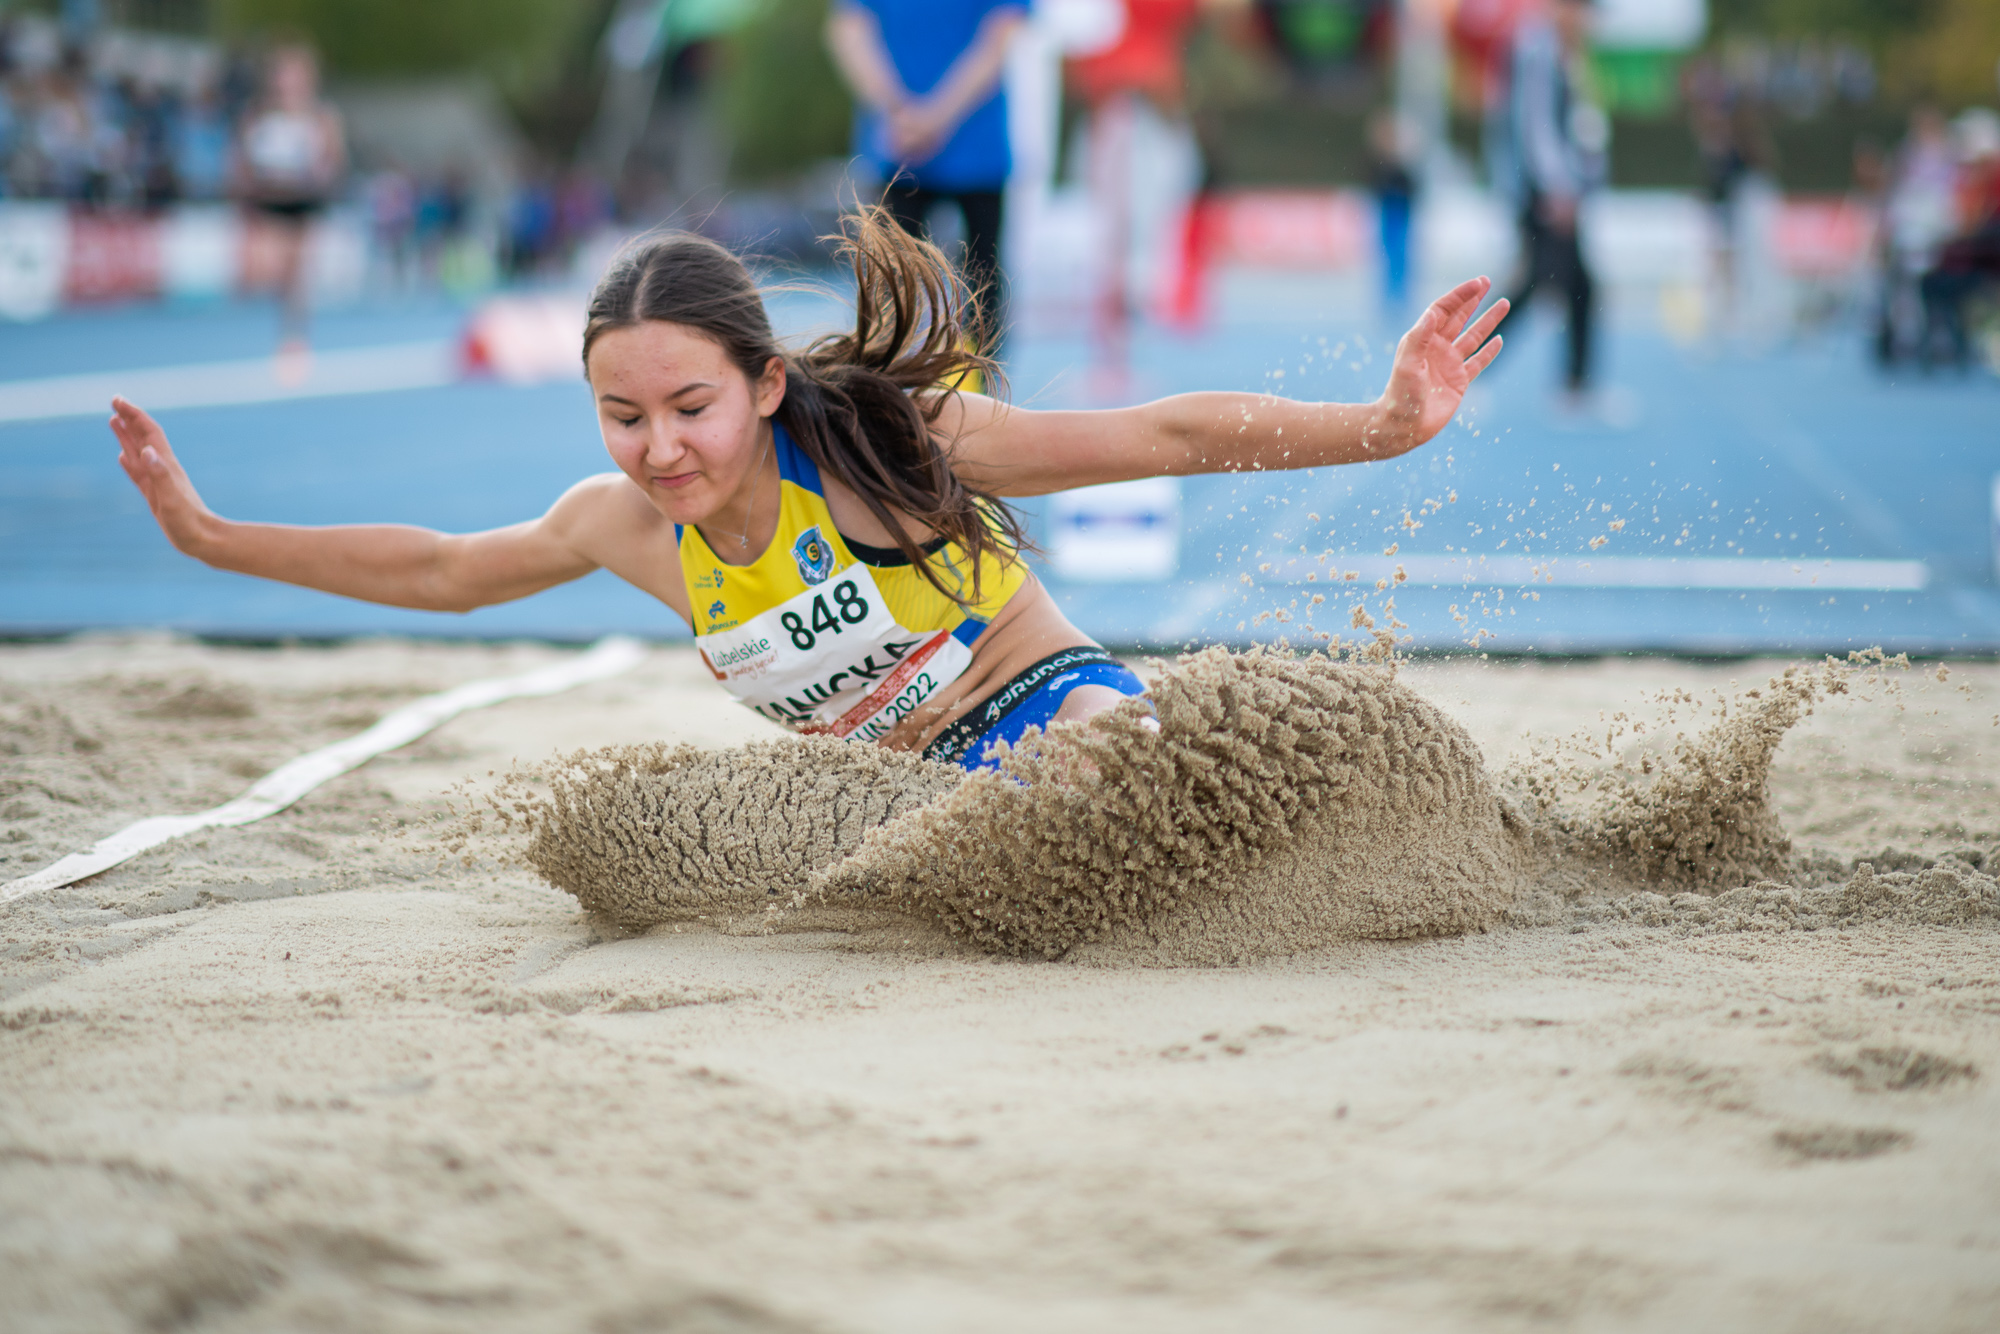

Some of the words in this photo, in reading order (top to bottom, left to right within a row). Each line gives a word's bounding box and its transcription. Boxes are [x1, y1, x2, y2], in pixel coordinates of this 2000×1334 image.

[781, 580, 869, 651] 848
[711, 638, 771, 667] Lubelskie
[886, 672, 939, 722] 2022
